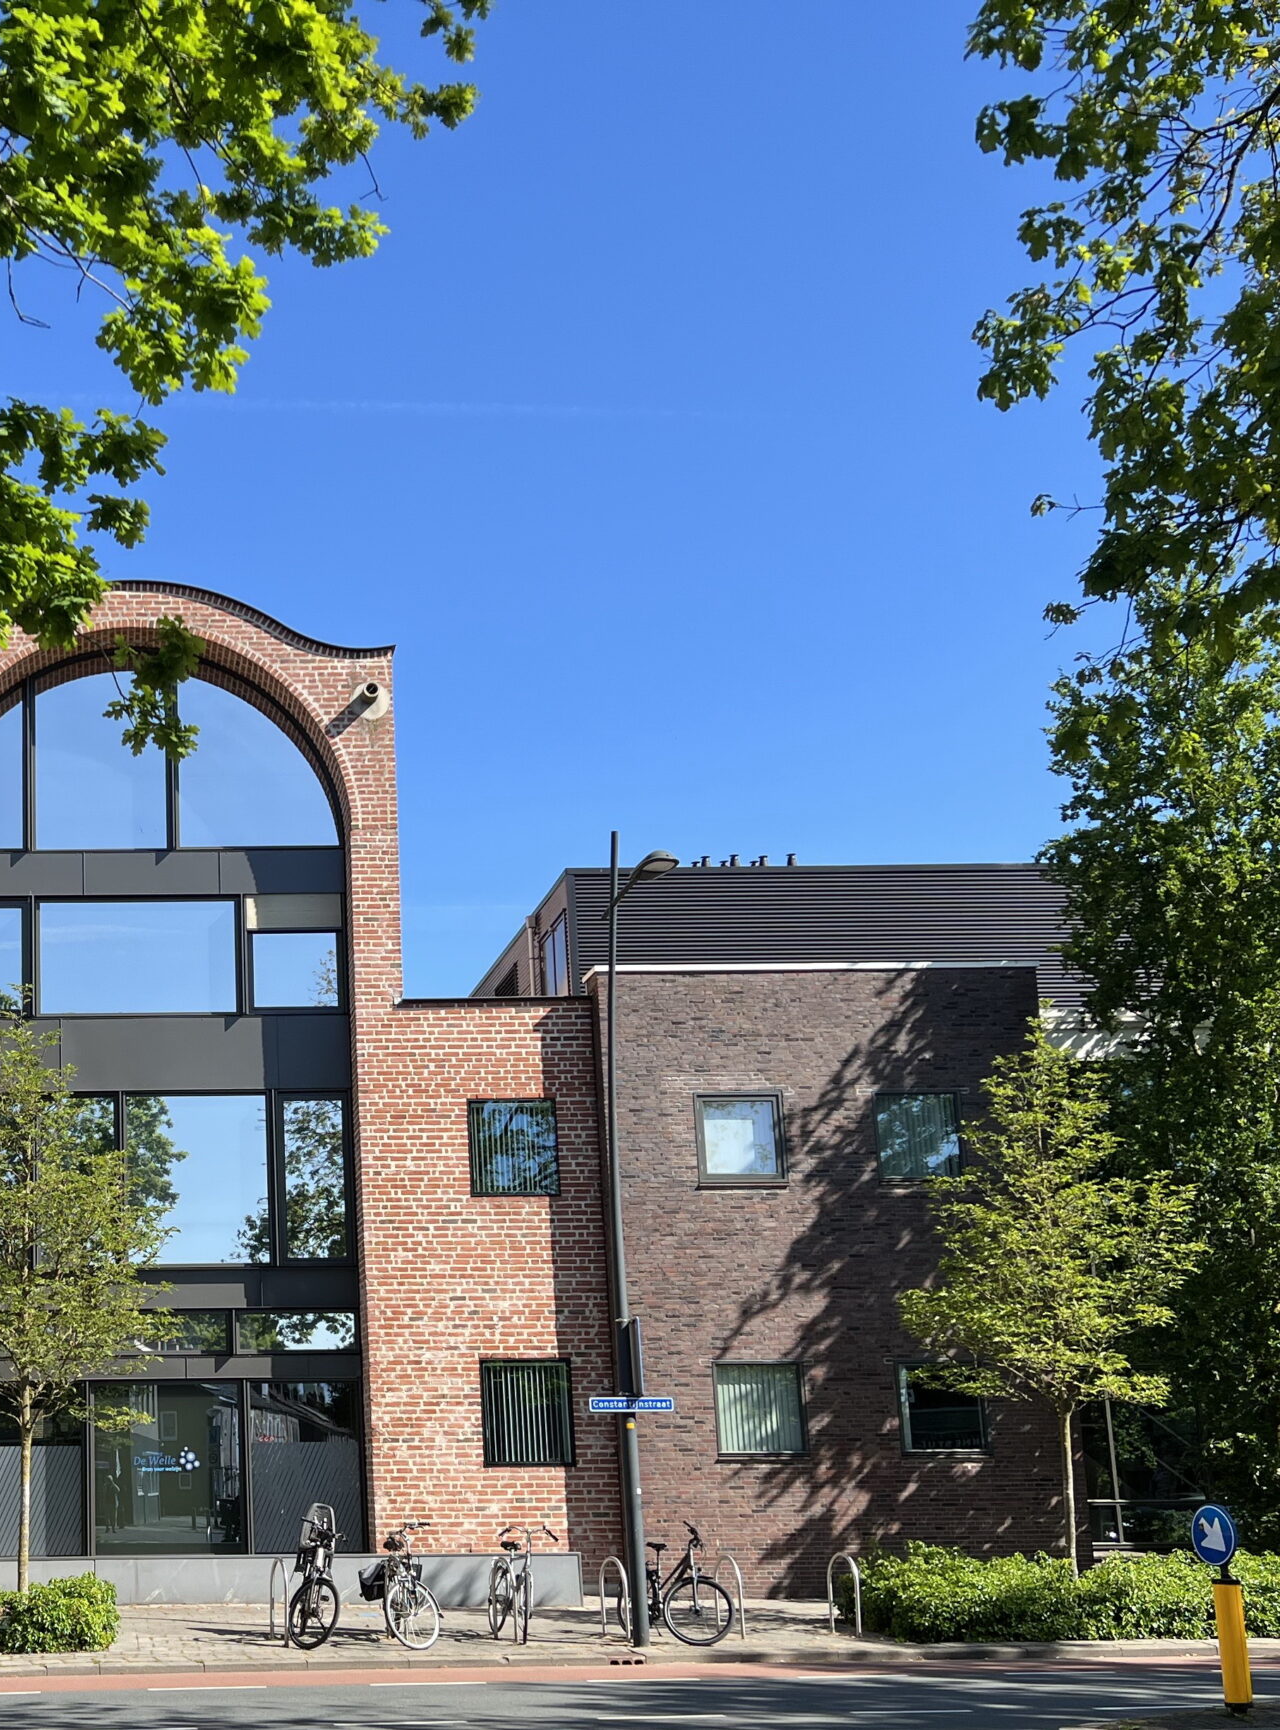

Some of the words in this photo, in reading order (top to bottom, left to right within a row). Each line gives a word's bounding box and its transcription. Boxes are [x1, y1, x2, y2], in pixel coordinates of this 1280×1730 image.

[592, 1400, 671, 1410] Constantijnstraat
[133, 1456, 146, 1466] De
[148, 1455, 177, 1466] Welle
